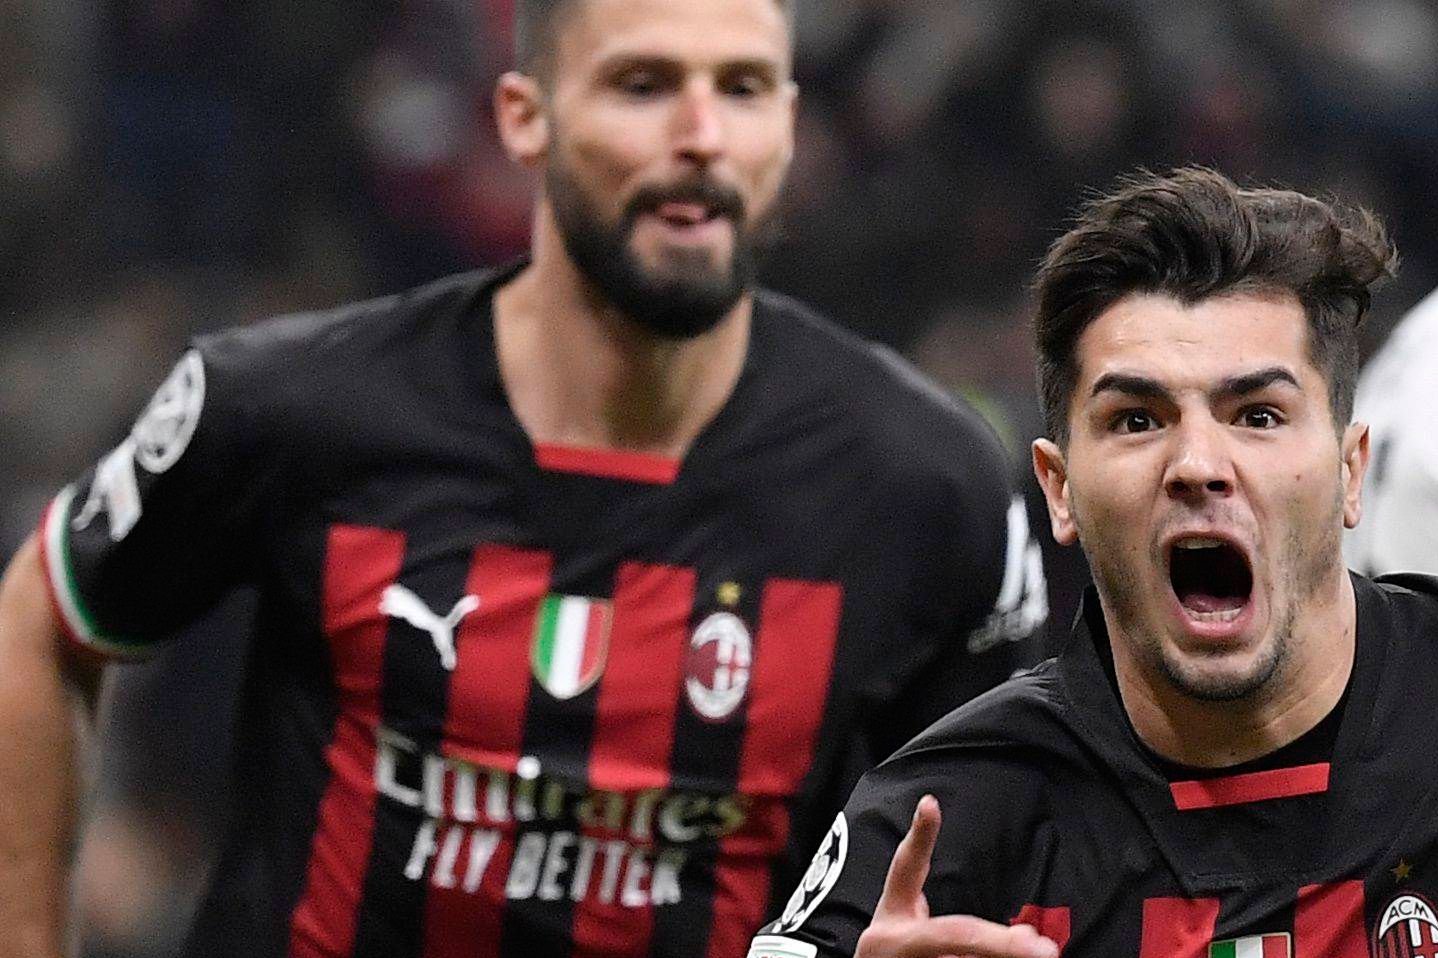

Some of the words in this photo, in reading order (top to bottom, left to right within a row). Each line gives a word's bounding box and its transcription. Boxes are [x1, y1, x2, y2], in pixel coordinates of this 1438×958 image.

[404, 817, 502, 893] FLY
[504, 830, 682, 907] BETTER
[1386, 899, 1430, 925] ACM
